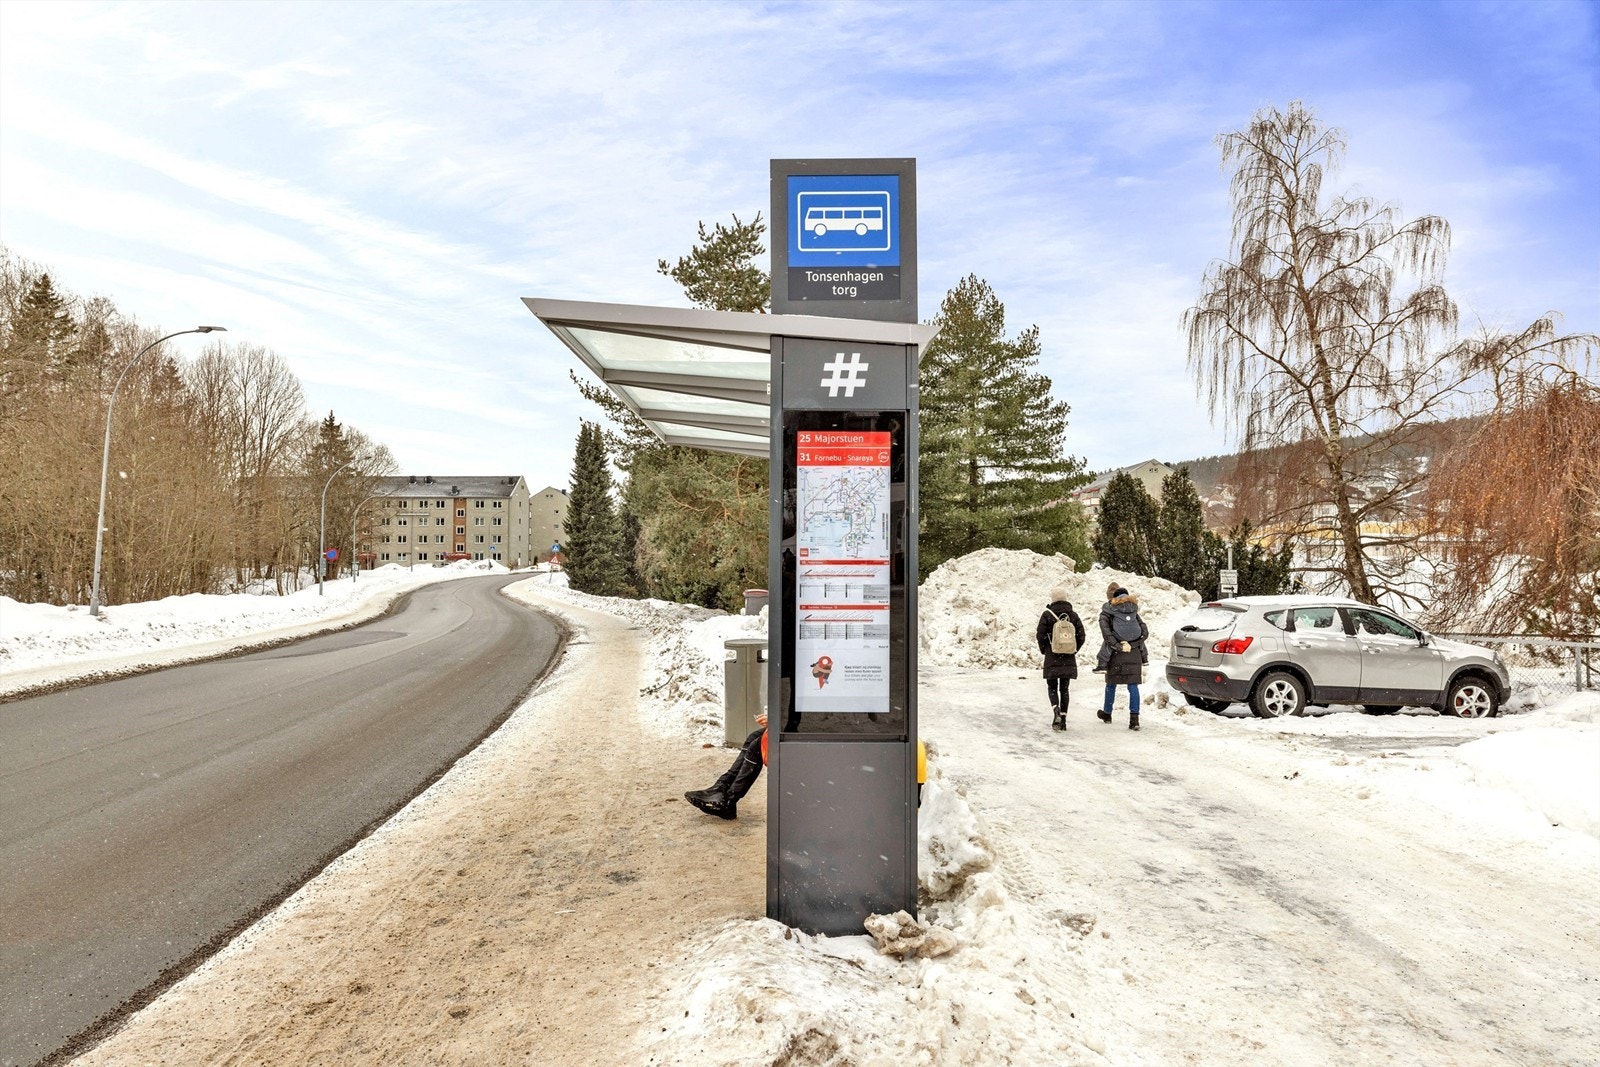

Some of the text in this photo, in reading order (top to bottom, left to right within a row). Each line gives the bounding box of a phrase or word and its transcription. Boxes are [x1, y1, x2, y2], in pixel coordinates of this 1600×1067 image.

[805, 271, 884, 284] Tonsenhagen
[832, 286, 857, 297] torg
[800, 434, 864, 446] 25 Majorstuen
[800, 452, 811, 461] 31
